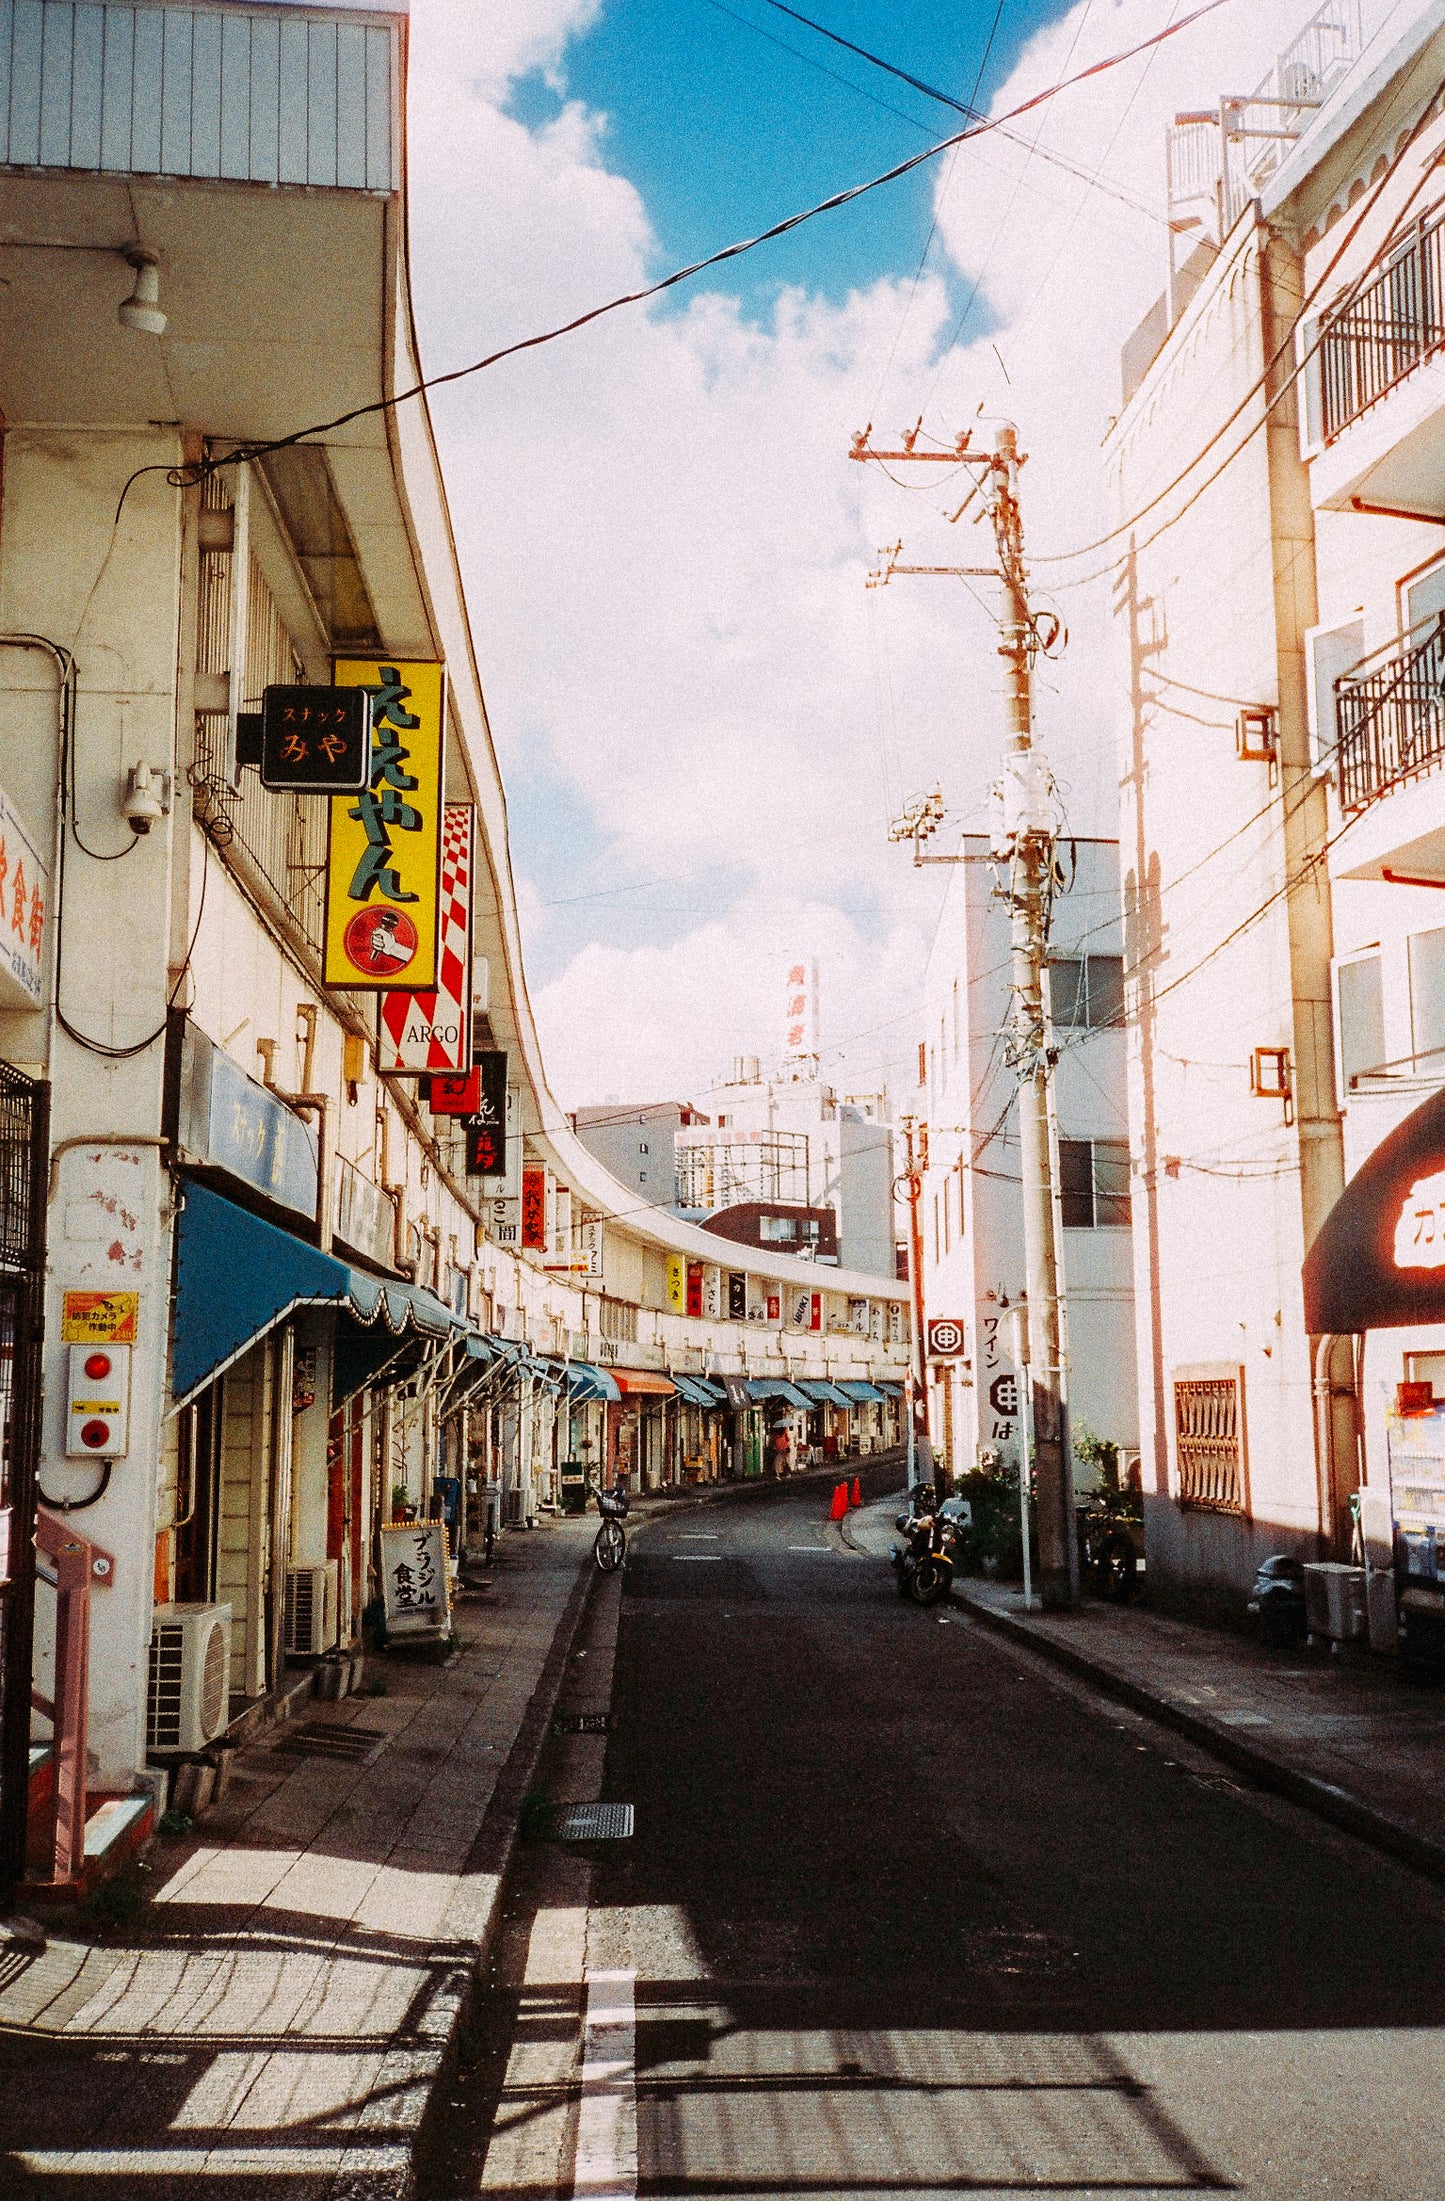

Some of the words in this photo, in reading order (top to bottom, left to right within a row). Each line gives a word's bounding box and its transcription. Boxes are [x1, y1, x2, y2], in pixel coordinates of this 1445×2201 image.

[282, 707, 348, 723] スナック
[278, 733, 348, 764] みや
[347, 665, 423, 903] ええやん
[407, 1025, 458, 1043] ARGO
[671, 1267, 680, 1300] さつき
[72, 1311, 117, 1321] 防犯カメラ
[793, 1295, 809, 1324] IBUKI
[89, 1322, 117, 1332] 作動中
[413, 1530, 436, 1604] ブラジル
[392, 1562, 418, 1608] 食堂
